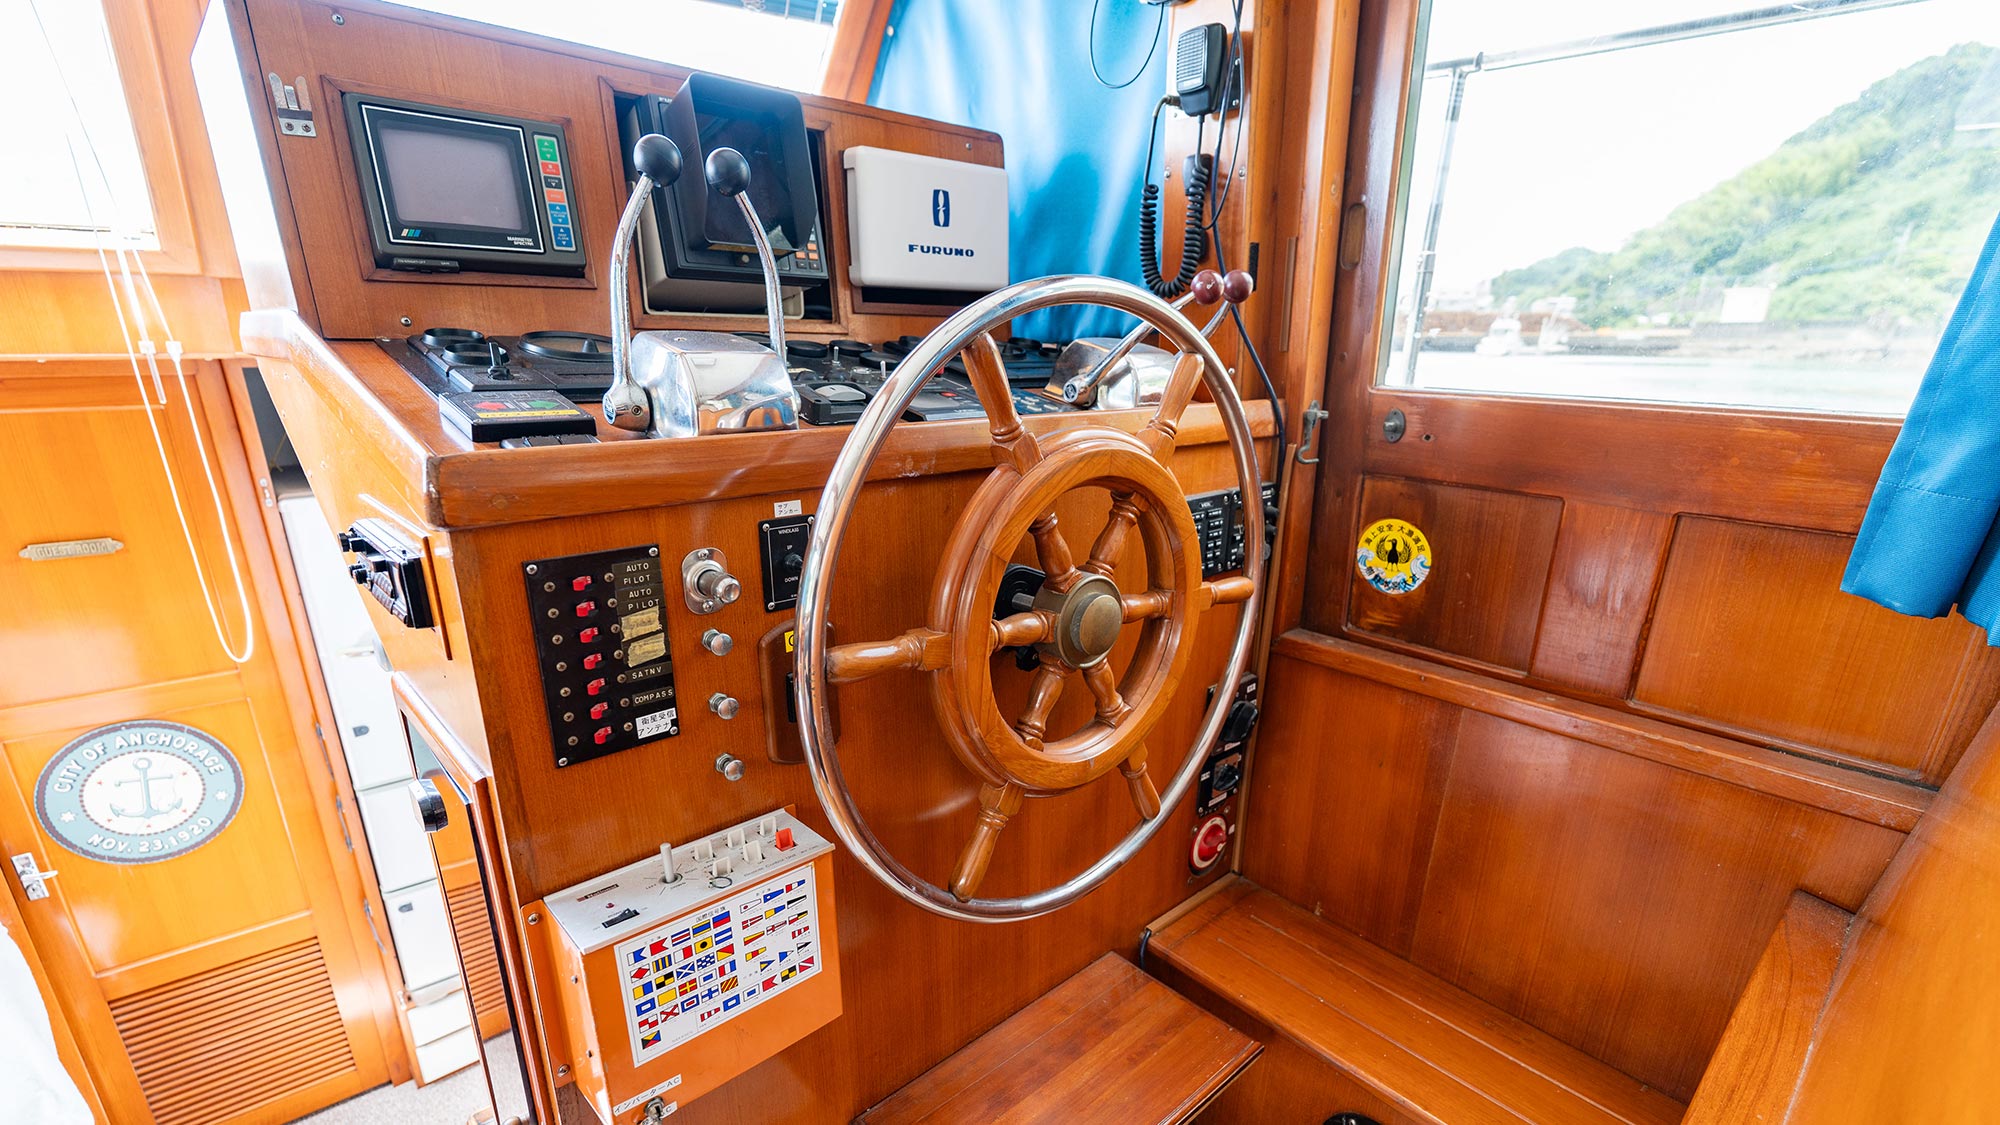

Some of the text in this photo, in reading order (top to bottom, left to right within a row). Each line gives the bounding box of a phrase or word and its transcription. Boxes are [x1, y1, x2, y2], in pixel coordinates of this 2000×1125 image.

[908, 244, 975, 257] FURUNO
[36, 541, 109, 559] GUEST ROOM
[626, 562, 649, 573] AUTO
[623, 574, 651, 585] PILOT
[628, 588, 652, 598] AUTO
[628, 598, 660, 611] PILOT
[632, 666, 662, 680] SATNV
[634, 688, 673, 704] COMPASS
[641, 709, 675, 726] 衛星受信
[638, 722, 670, 737] アンテナ
[53, 731, 226, 794] CITY OF ANCHORAGE
[87, 832, 132, 854] NOV.
